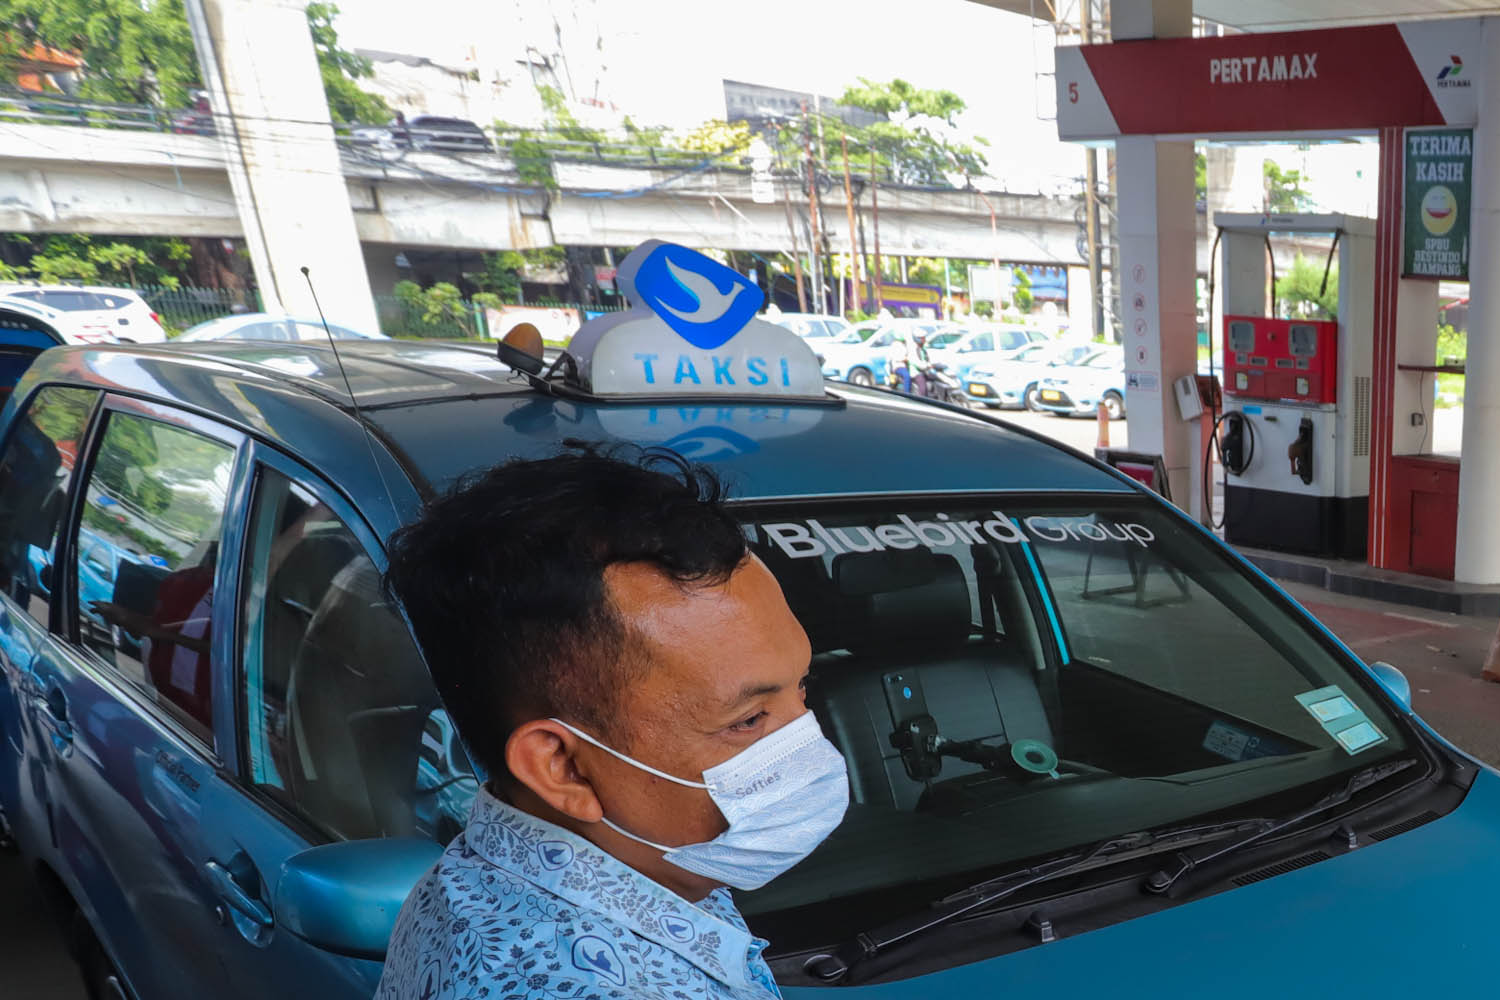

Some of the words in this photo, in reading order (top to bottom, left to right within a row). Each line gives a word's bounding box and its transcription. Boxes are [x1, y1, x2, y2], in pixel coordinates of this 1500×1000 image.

[1209, 53, 1318, 84] PERTAMAX
[1068, 82, 1079, 104] 5
[1410, 135, 1471, 156] TERIMA
[1415, 162, 1464, 182] KASIH
[633, 353, 791, 387] TAKSI
[735, 771, 781, 800] Softies
